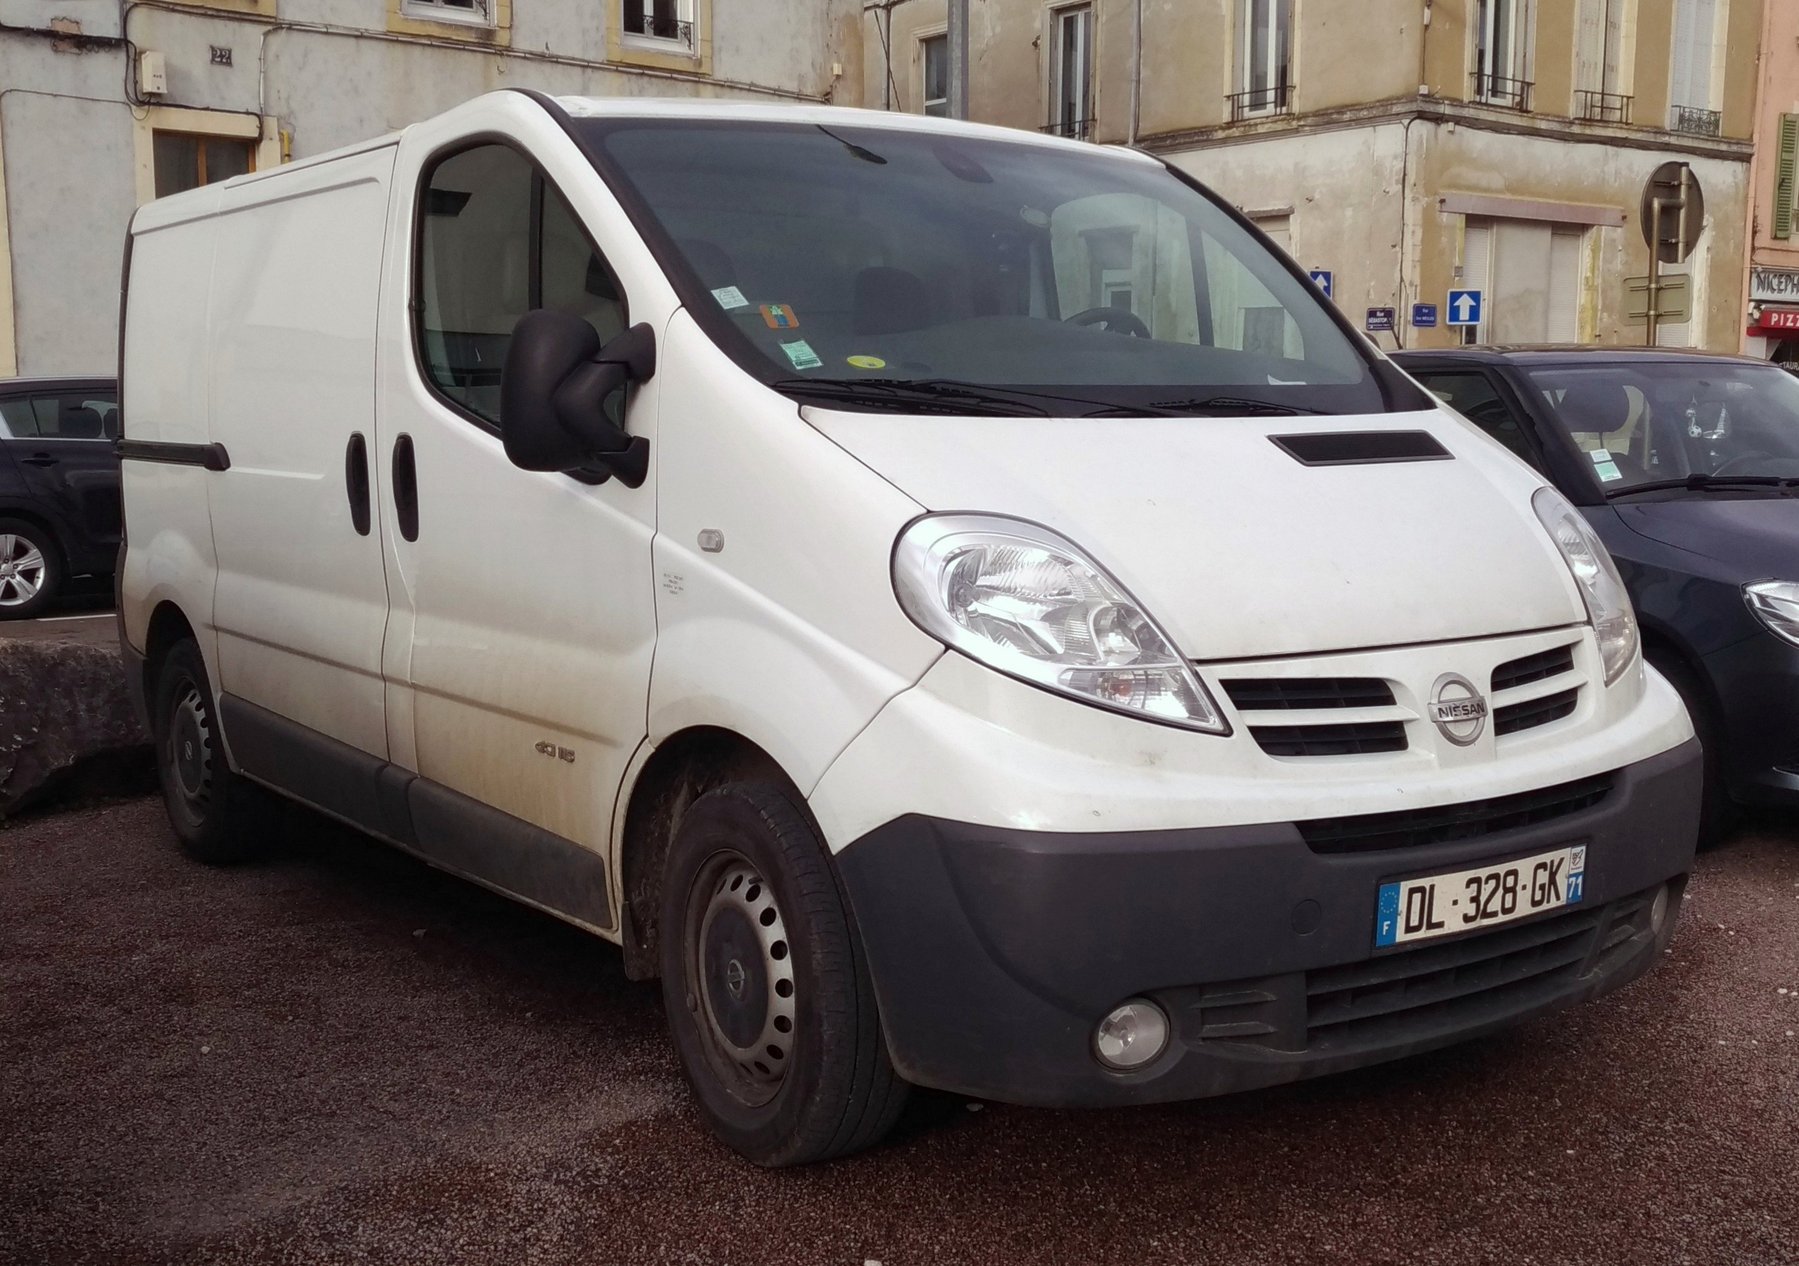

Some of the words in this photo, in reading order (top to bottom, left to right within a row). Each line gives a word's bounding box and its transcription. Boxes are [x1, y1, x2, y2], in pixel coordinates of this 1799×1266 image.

[213, 48, 230, 63] 22
[1438, 702, 1485, 718] NISSAN
[1568, 875, 1583, 898] 71
[1382, 921, 1391, 935] F
